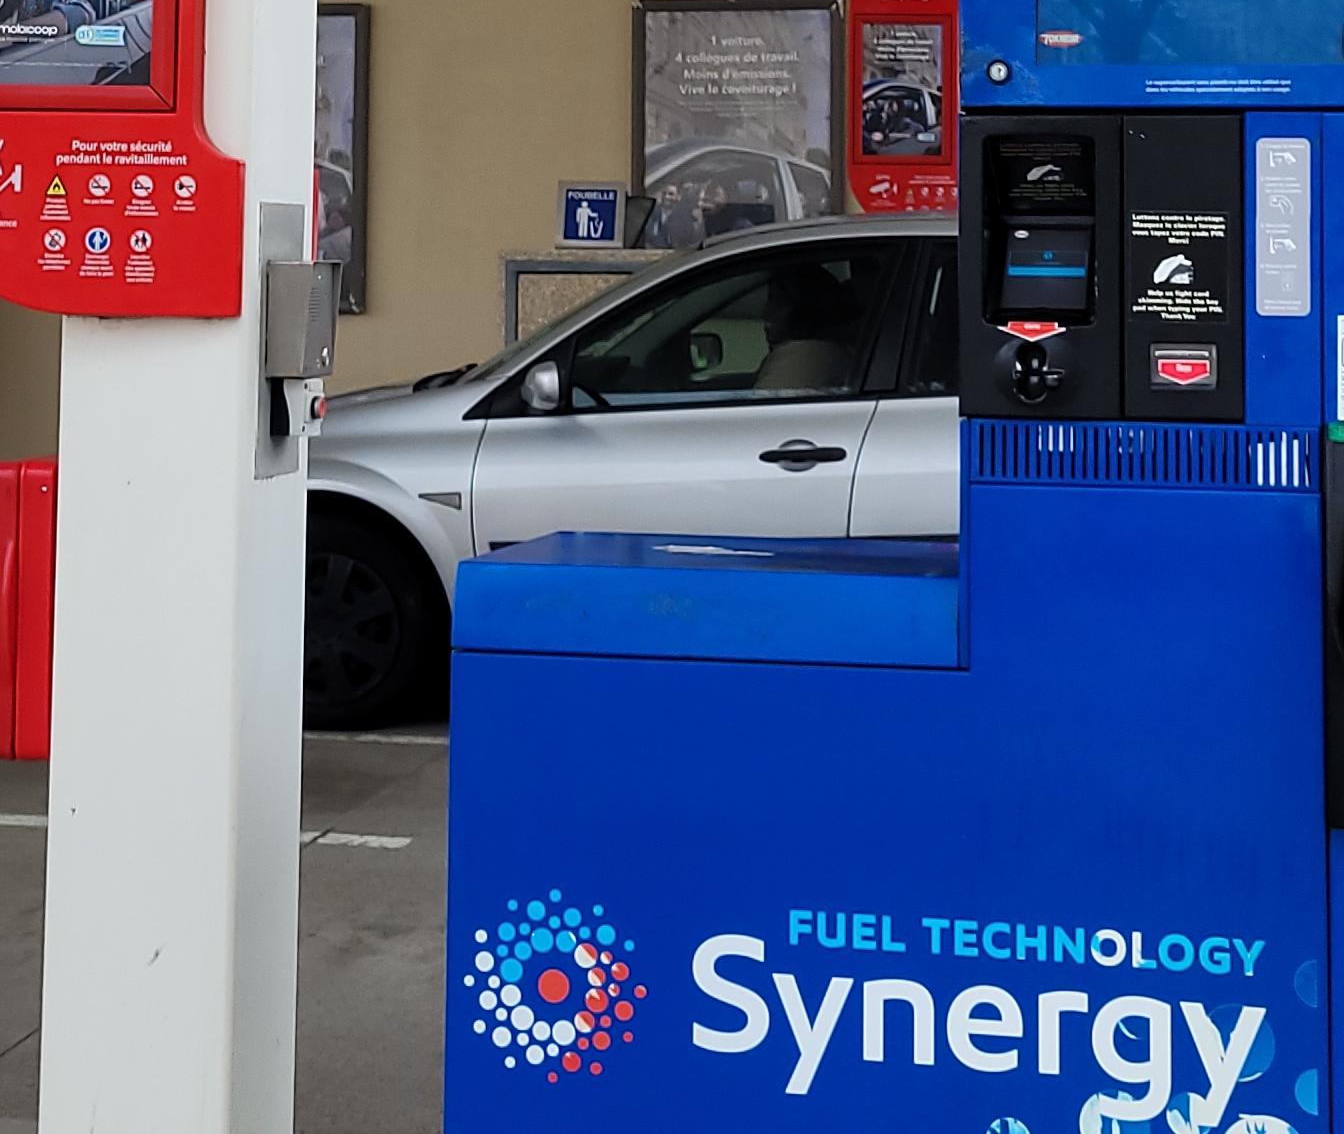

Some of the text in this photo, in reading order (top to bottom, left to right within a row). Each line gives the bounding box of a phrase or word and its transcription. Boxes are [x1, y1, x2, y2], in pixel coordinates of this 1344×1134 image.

[72, 140, 172, 153] Pour votre sécurité
[56, 153, 188, 166] pendant le ravitaillement
[568, 191, 615, 201] POUBELLE
[788, 909, 1267, 978] FUEL TECHNOLOGY
[691, 933, 1267, 1128] Synergy
